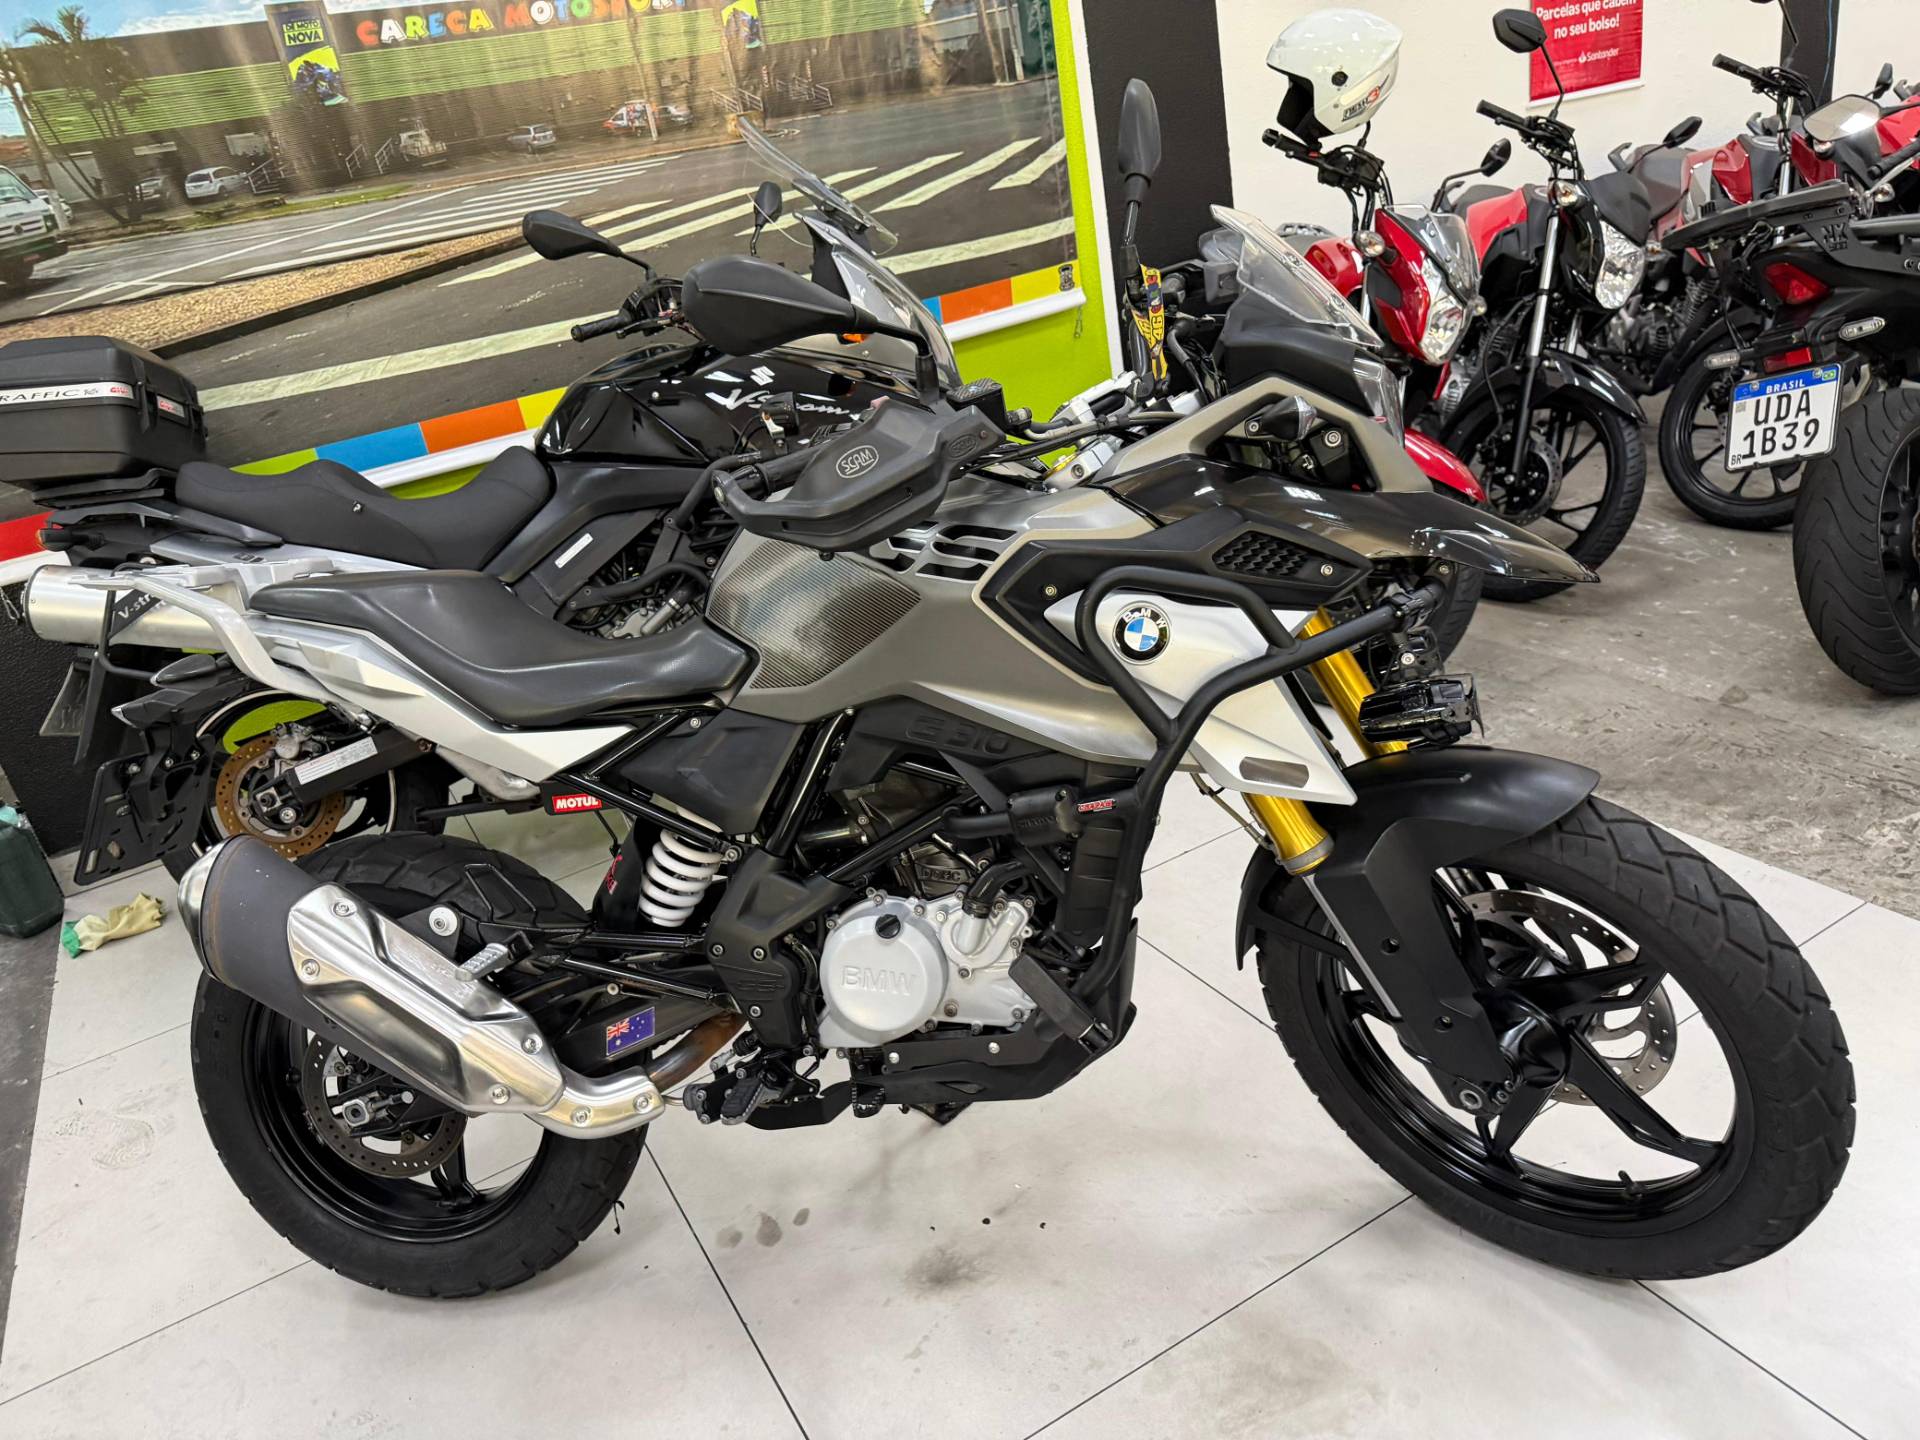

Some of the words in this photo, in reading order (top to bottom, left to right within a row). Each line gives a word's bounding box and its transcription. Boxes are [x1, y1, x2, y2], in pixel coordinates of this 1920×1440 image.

[1536, 2, 1580, 21] Parcelas
[1582, 0, 1601, 16] que
[287, 30, 322, 44] NOVA
[356, 8, 495, 46] CARECA
[1554, 27, 1568, 39] no
[1569, 22, 1587, 35] seu
[1589, 13, 1620, 32] bolso!
[1586, 47, 1619, 61] Santander
[1766, 379, 1806, 394] BRASIL
[1753, 389, 1810, 426] UDA
[1741, 418, 1820, 460] 1B39
[841, 448, 875, 475] SCAM
[1731, 454, 1742, 466] BR
[1121, 607, 1168, 629] BMW
[556, 796, 599, 809] MOTUL
[841, 965, 918, 996] BMW
